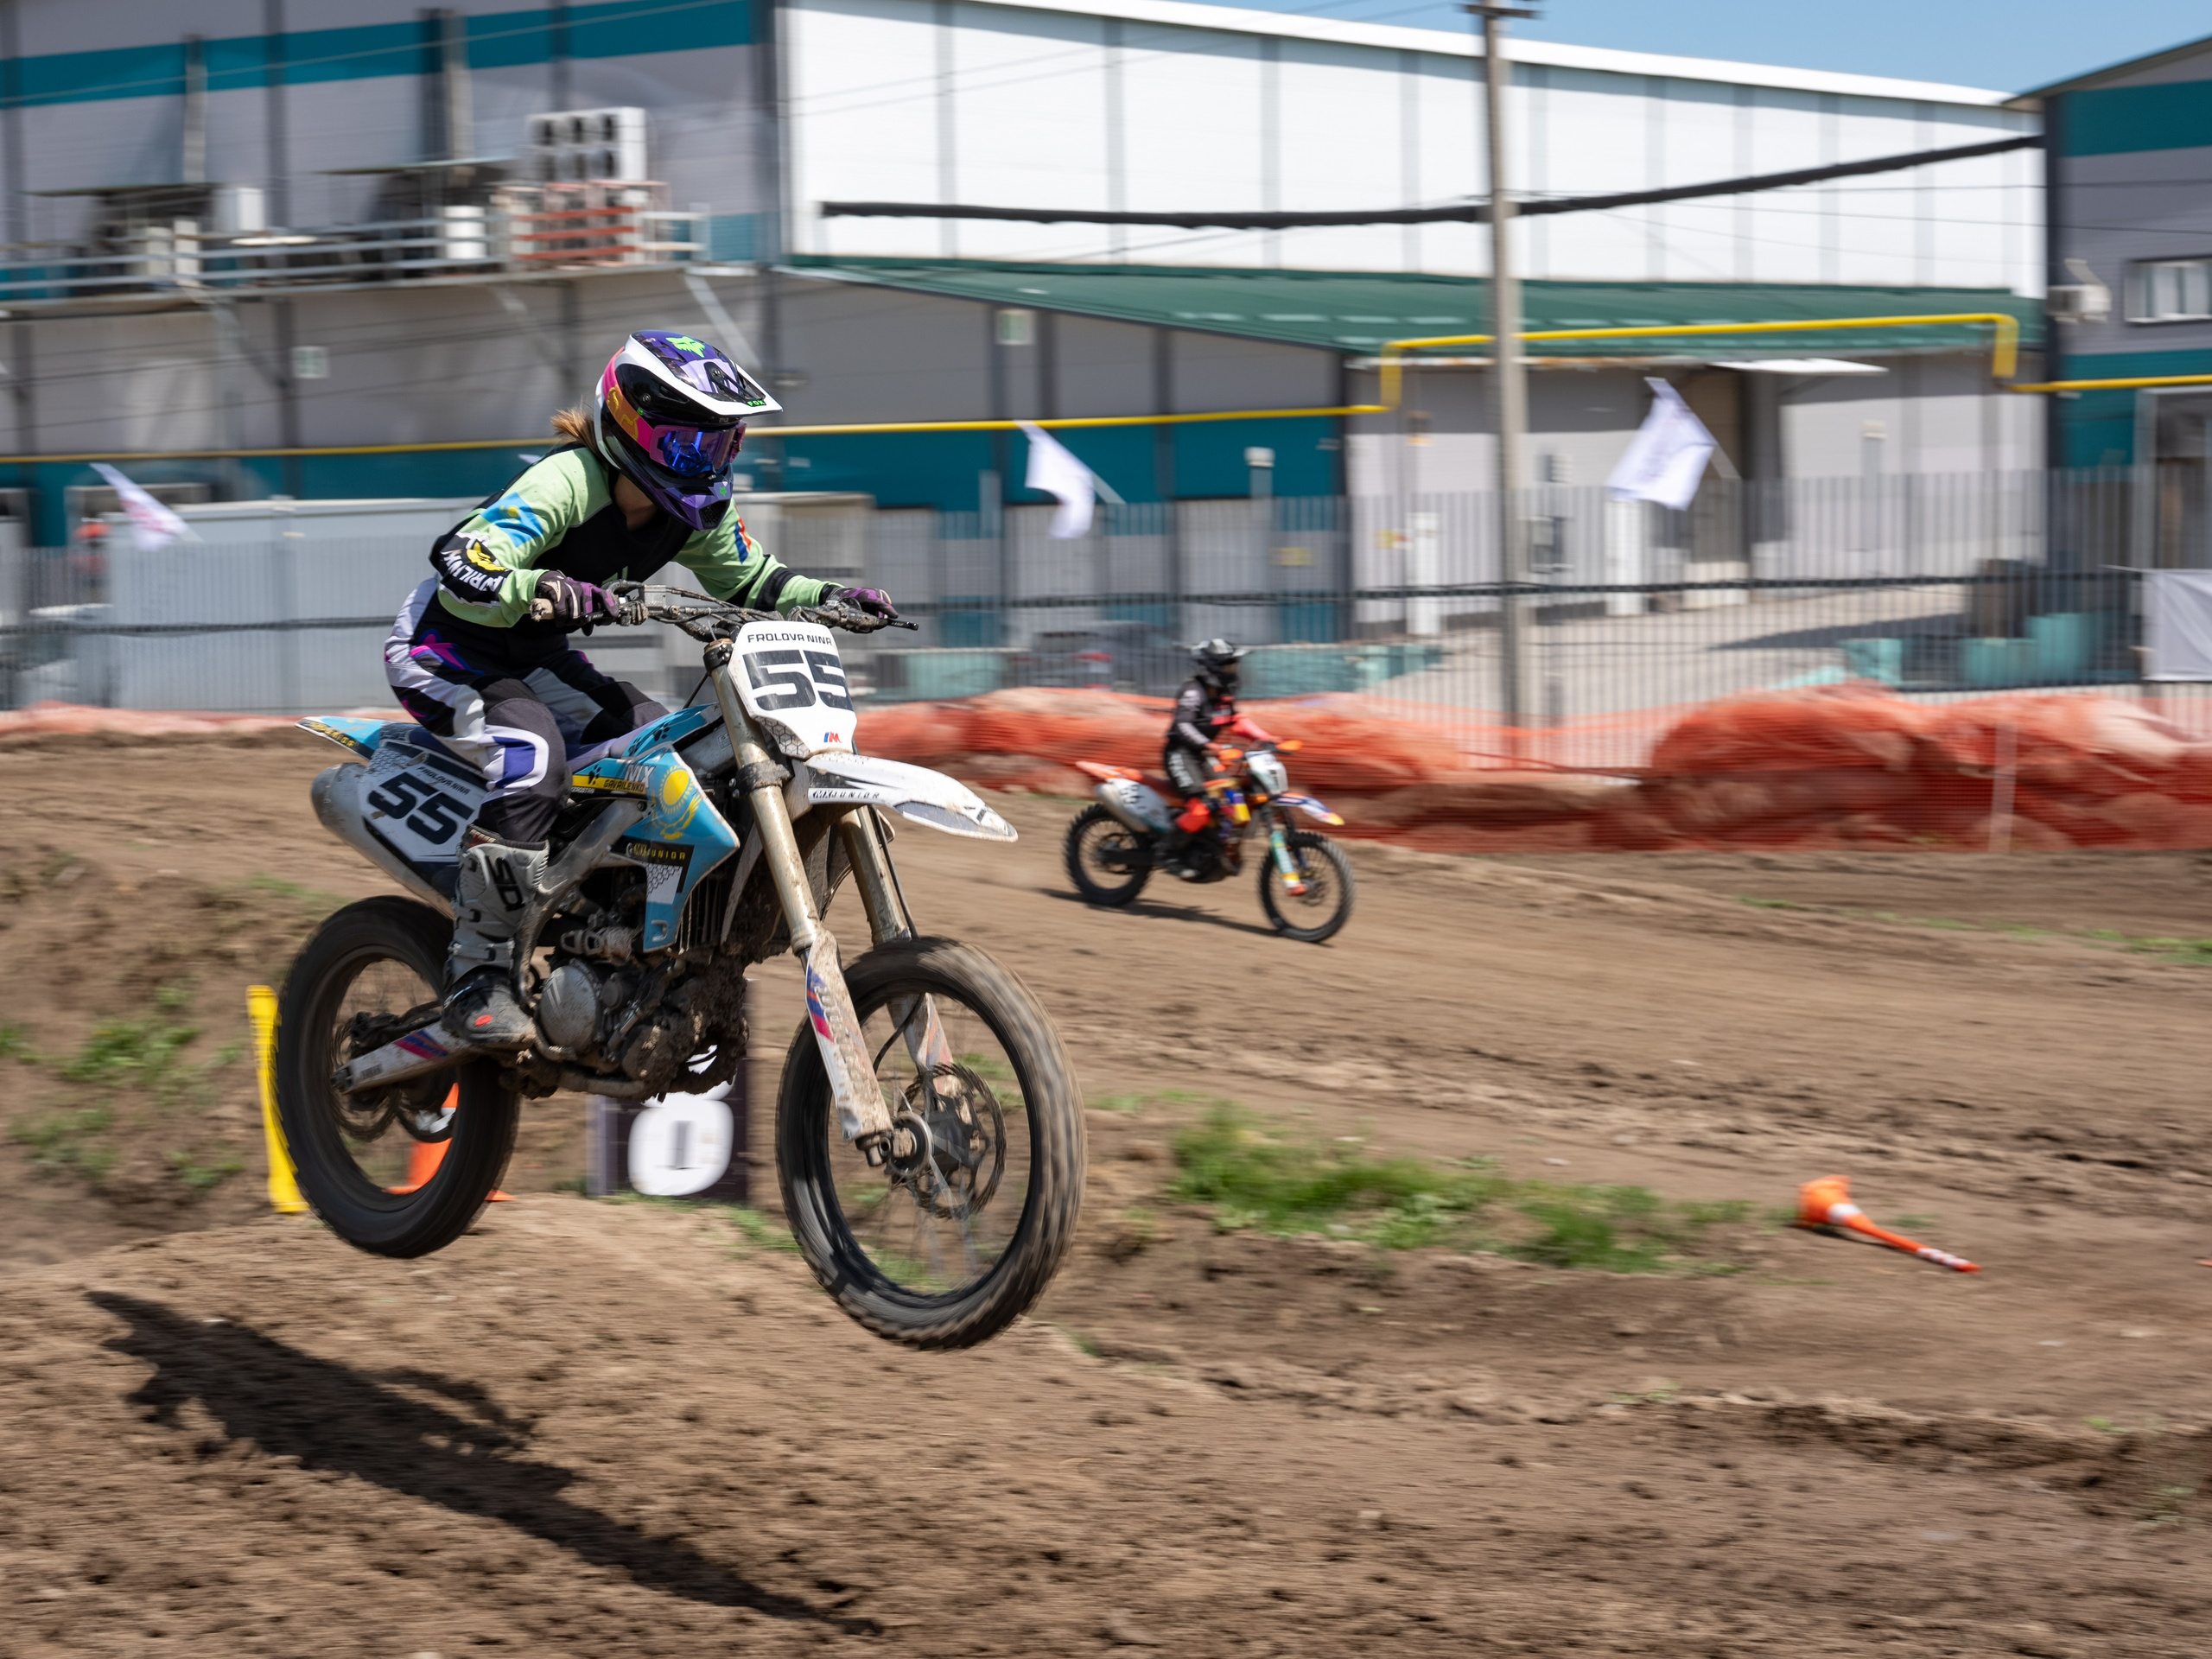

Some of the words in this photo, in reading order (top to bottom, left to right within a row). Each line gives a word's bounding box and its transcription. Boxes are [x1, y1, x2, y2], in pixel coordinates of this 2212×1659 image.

[747, 633, 805, 644] FROLOVA
[806, 634, 832, 645] NINA
[741, 649, 855, 711] 55
[367, 772, 474, 844] 55
